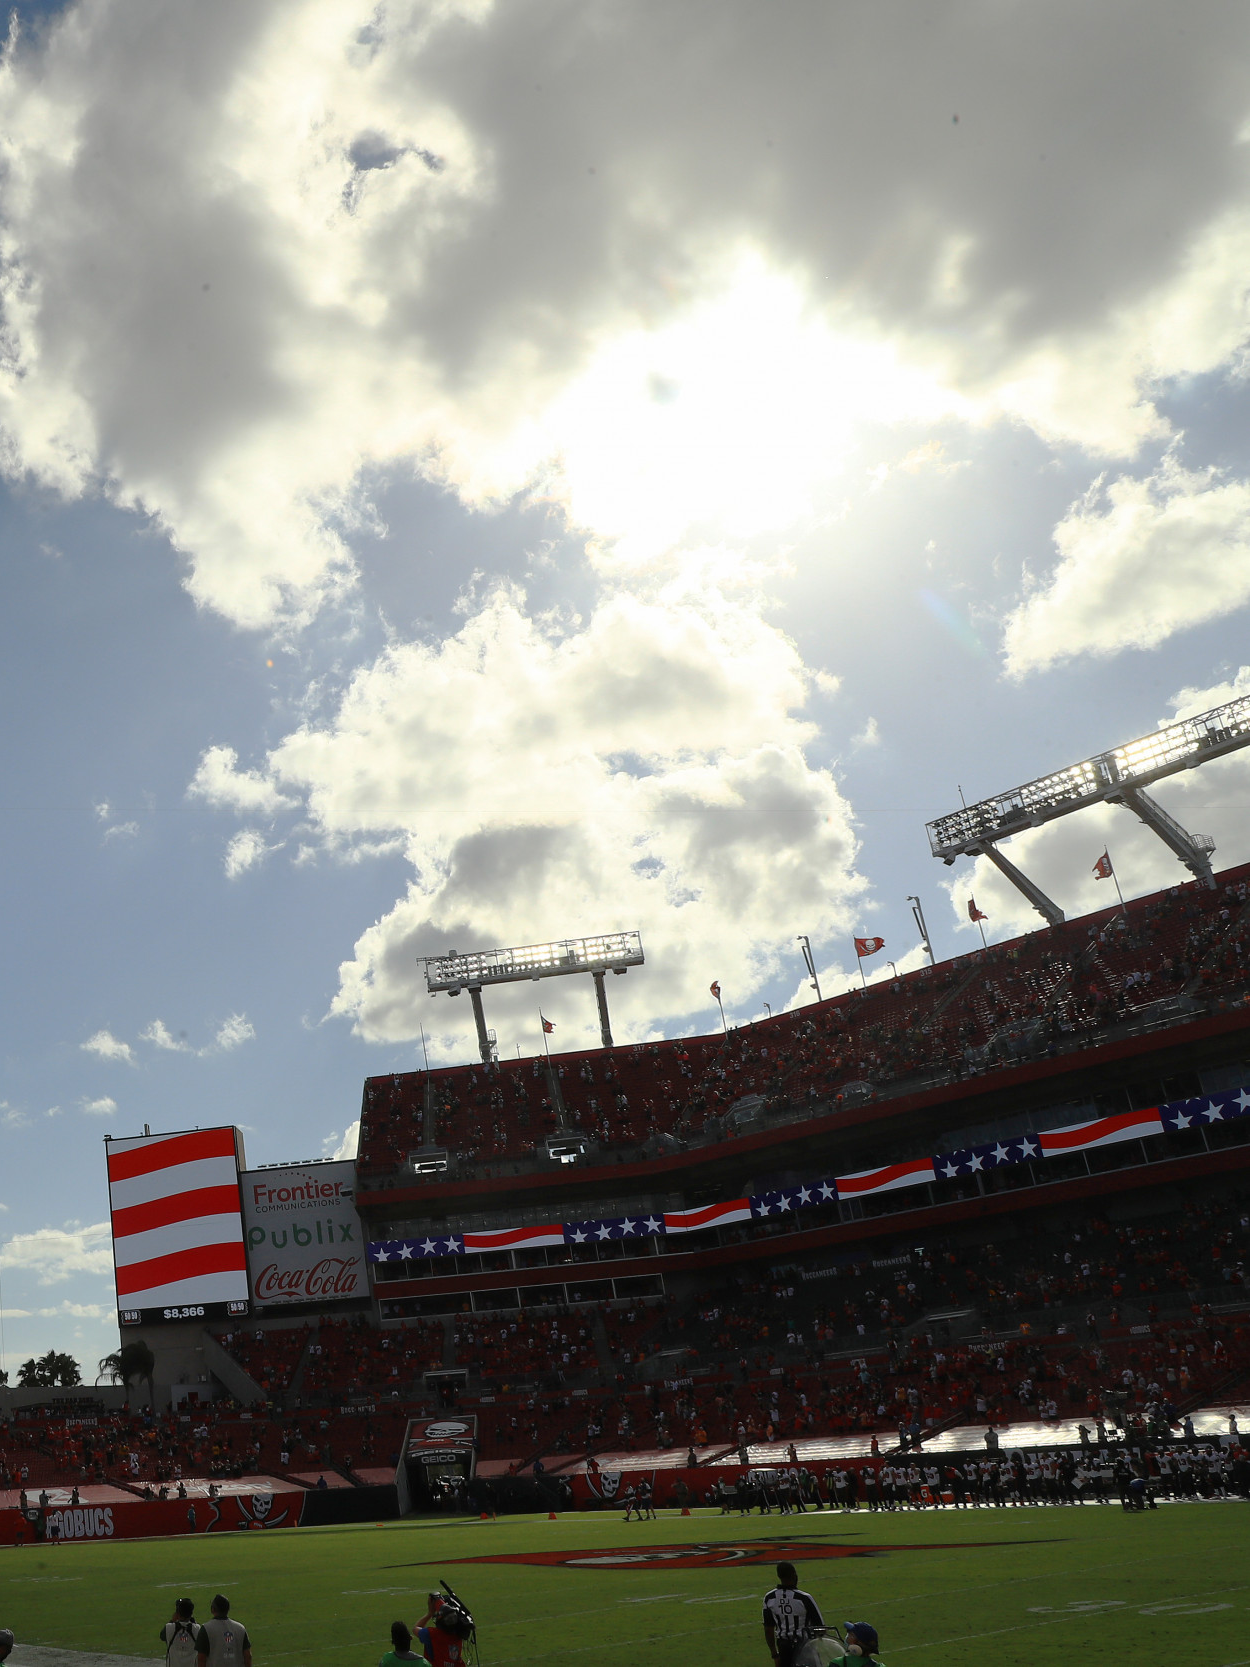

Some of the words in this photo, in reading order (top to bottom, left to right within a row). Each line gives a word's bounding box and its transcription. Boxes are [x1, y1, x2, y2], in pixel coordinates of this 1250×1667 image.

[253, 1180, 344, 1205] Frontier
[255, 1198, 341, 1214] COMMUNICATIONS
[255, 1256, 362, 1300] Coca-Cola
[163, 1306, 205, 1319] $8,366
[421, 1454, 456, 1464] GEICO
[778, 1604, 792, 1614] 10
